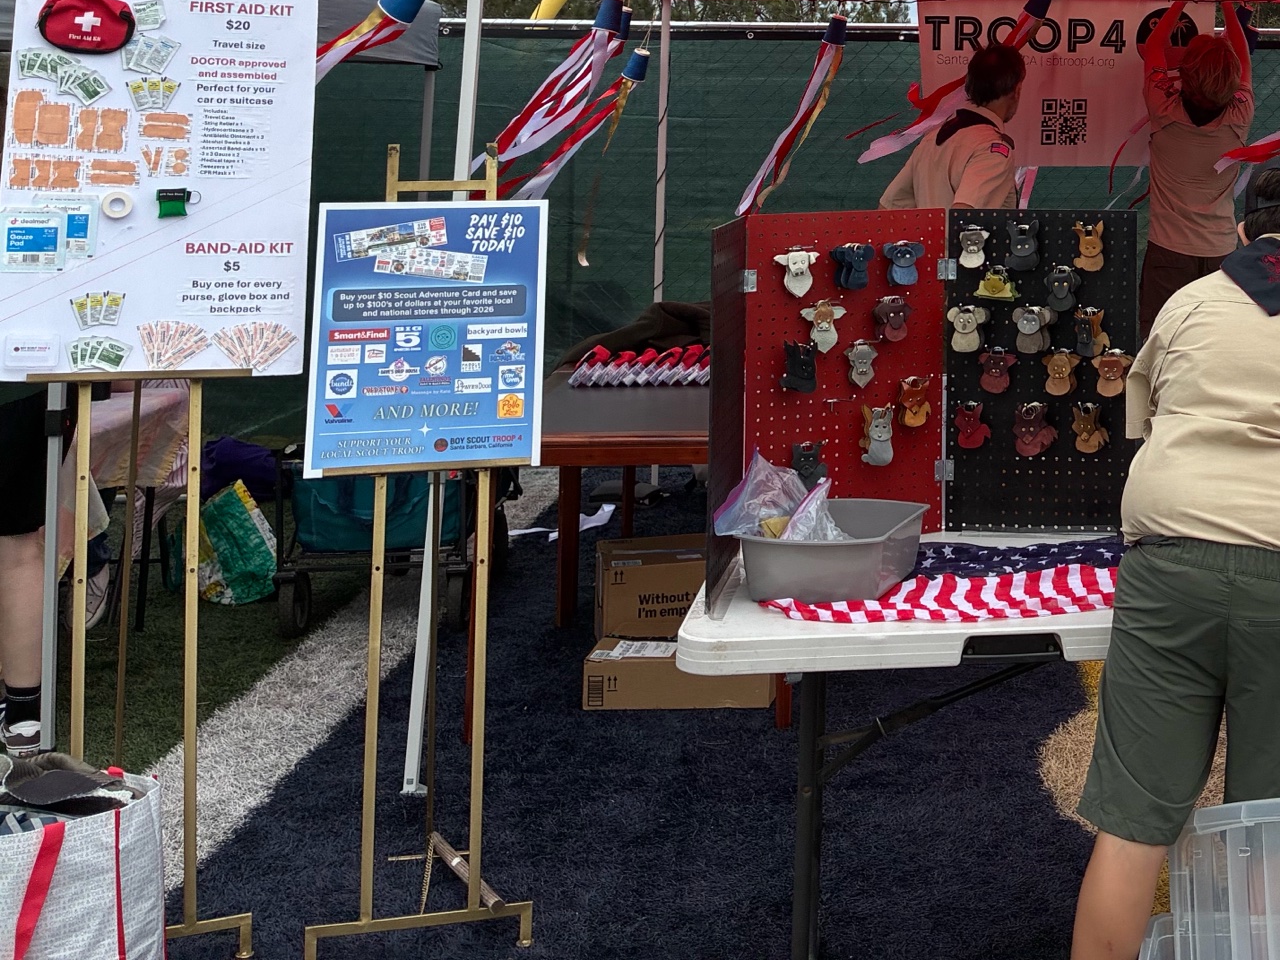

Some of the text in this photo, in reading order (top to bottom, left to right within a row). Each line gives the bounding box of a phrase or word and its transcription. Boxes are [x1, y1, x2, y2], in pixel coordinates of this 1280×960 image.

[190, 1, 294, 16] FIRST AID KIT
[226, 19, 250, 30] $20
[213, 40, 265, 50] Travel size
[191, 57, 286, 68] DOCTOR approved
[937, 54, 1115, 68] Santa sbtroop4.org
[221, 72, 277, 80] assembled
[197, 84, 275, 94] Perfect for your
[230, 97, 273, 105] suitcase
[470, 212, 523, 227] PAY $10
[466, 226, 525, 240] SAVE $10
[186, 242, 294, 254] BAND-AID KIT
[472, 239, 515, 253] TODAY
[223, 260, 240, 272] $5
[192, 280, 212, 289] Buy
[237, 280, 251, 288] for
[254, 281, 282, 289] every
[182, 294, 215, 302] purse,
[218, 293, 246, 302] glove
[270, 292, 290, 300] and
[378, 292, 392, 300] $10
[419, 290, 459, 298] Adventure
[367, 300, 392, 308] $100's
[405, 299, 431, 307] dollars
[210, 305, 261, 314] backpack
[441, 307, 471, 315] through
[334, 330, 387, 339] Smart&Final
[467, 327, 503, 335] backyard
[396, 332, 420, 347] 5
[374, 402, 479, 419] AND MORE!
[502, 400, 519, 410] Pollo
[338, 437, 411, 448] SUPPORT YOUR
[467, 436, 490, 444] SCOUT
[320, 446, 425, 459] LOCAL SCOUT TROOP
[638, 593, 690, 605] Without
[638, 607, 691, 619] I'm emp
